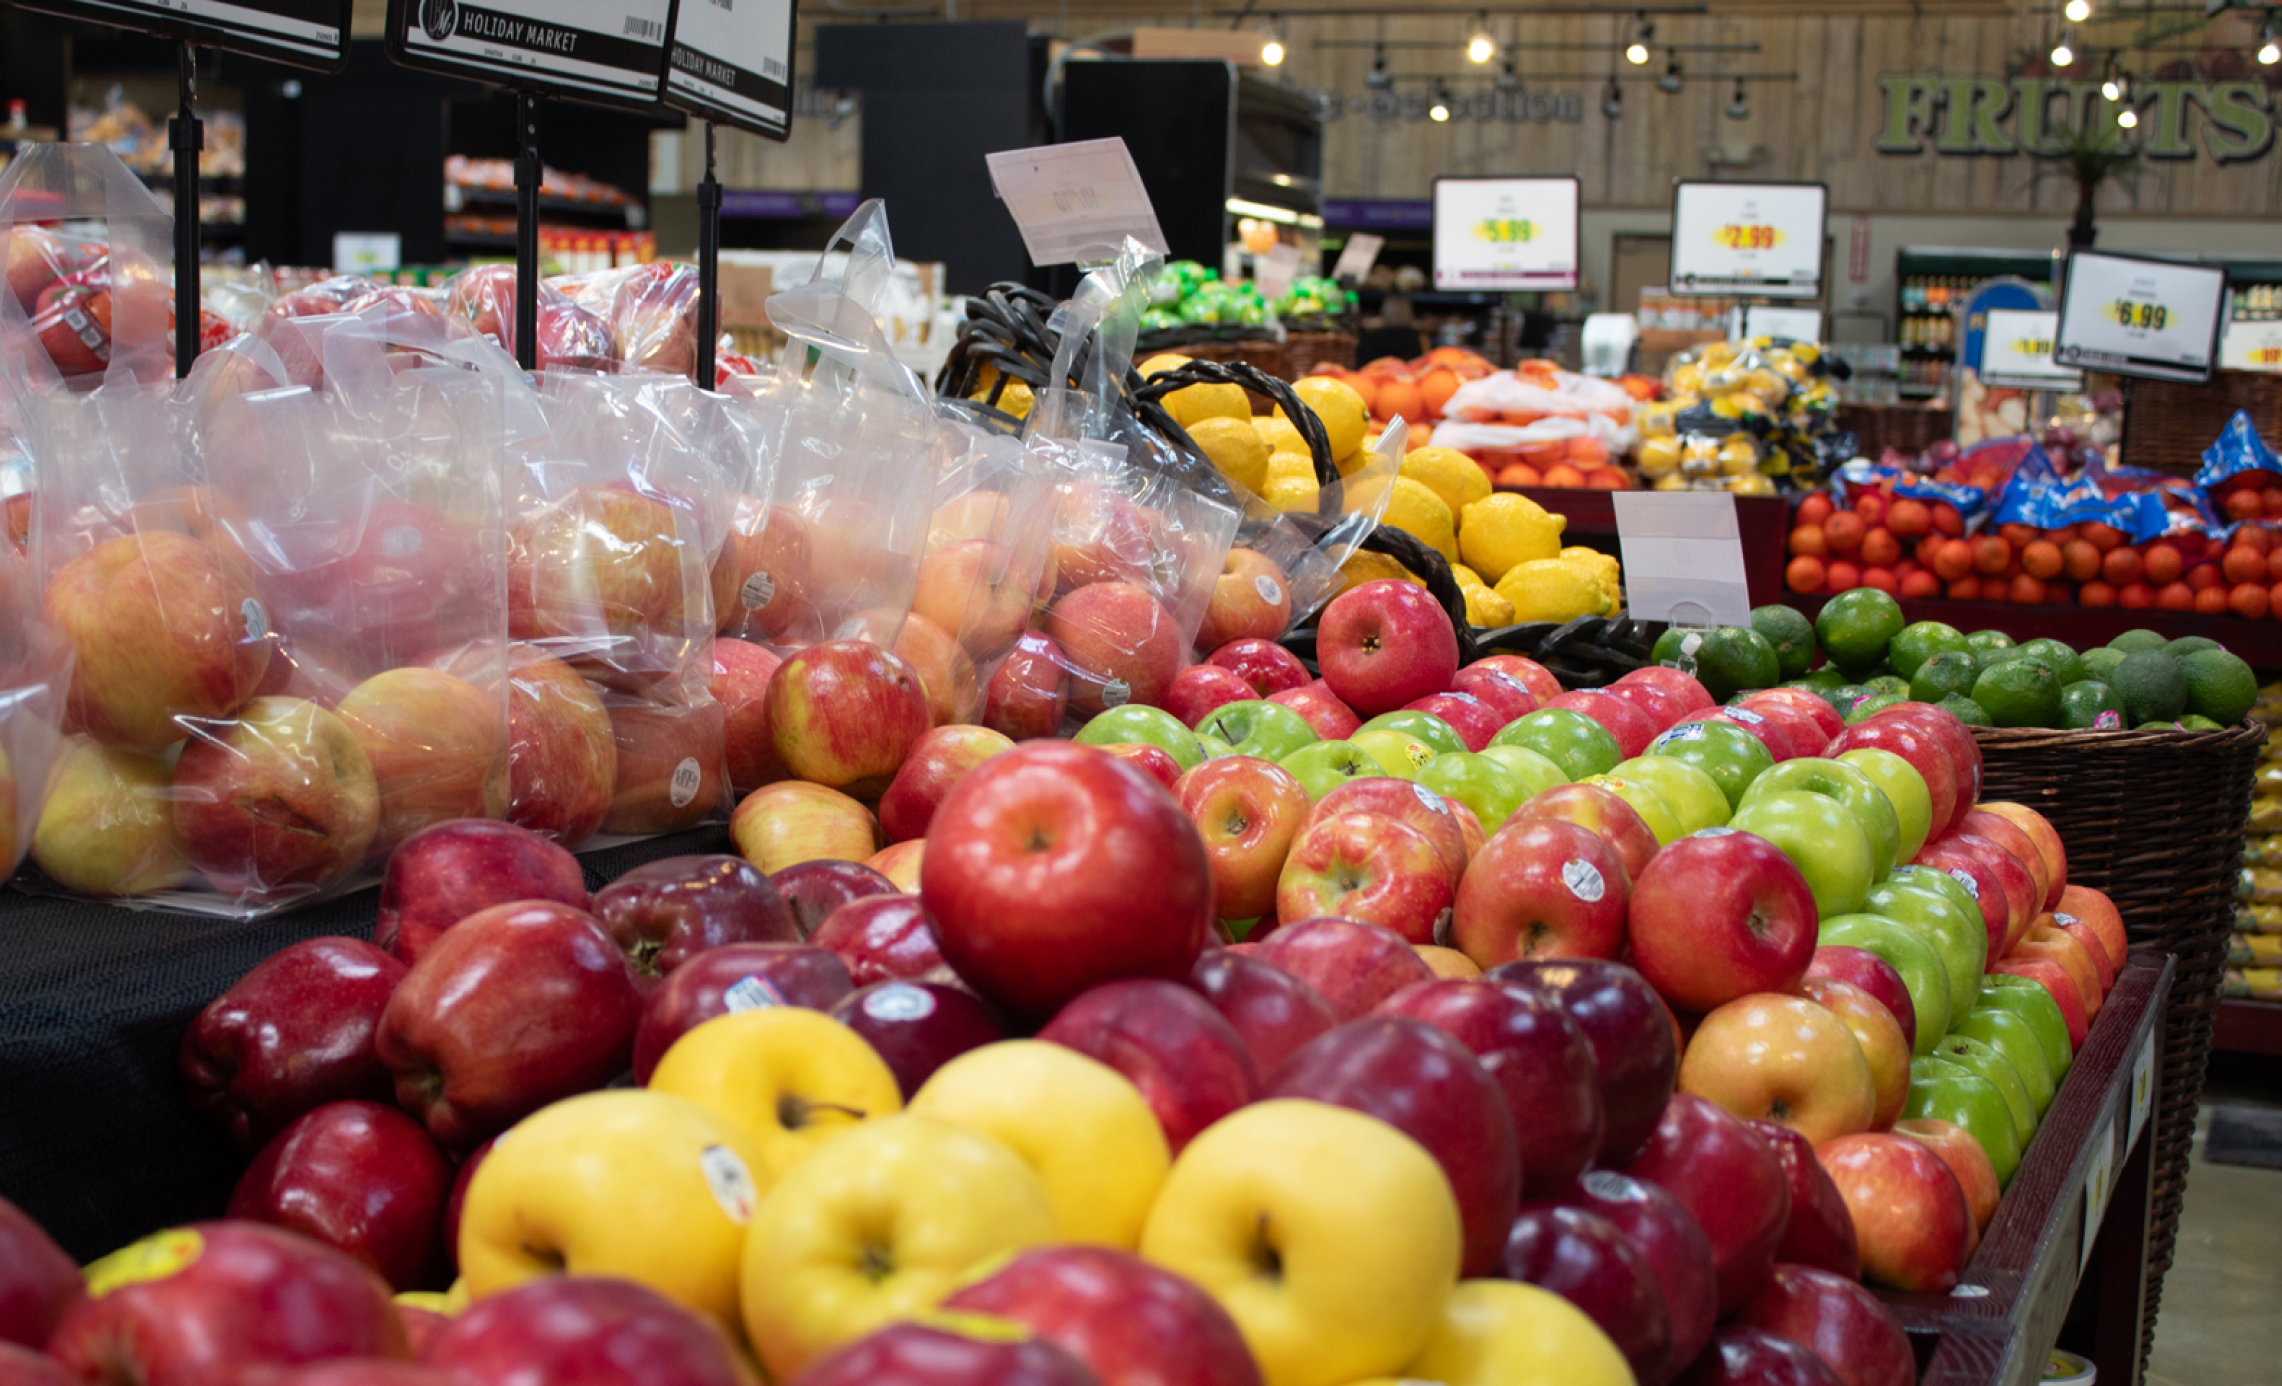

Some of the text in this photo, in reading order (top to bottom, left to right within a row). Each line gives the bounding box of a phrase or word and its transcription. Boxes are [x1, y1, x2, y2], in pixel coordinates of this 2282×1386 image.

[463, 11, 524, 41] HOLIDAY
[525, 25, 578, 53] MARKET
[671, 45, 737, 88] HOLIDAY MARKET
[1875, 75, 2275, 165] FRUITS
[2114, 296, 2169, 332] $6.99
